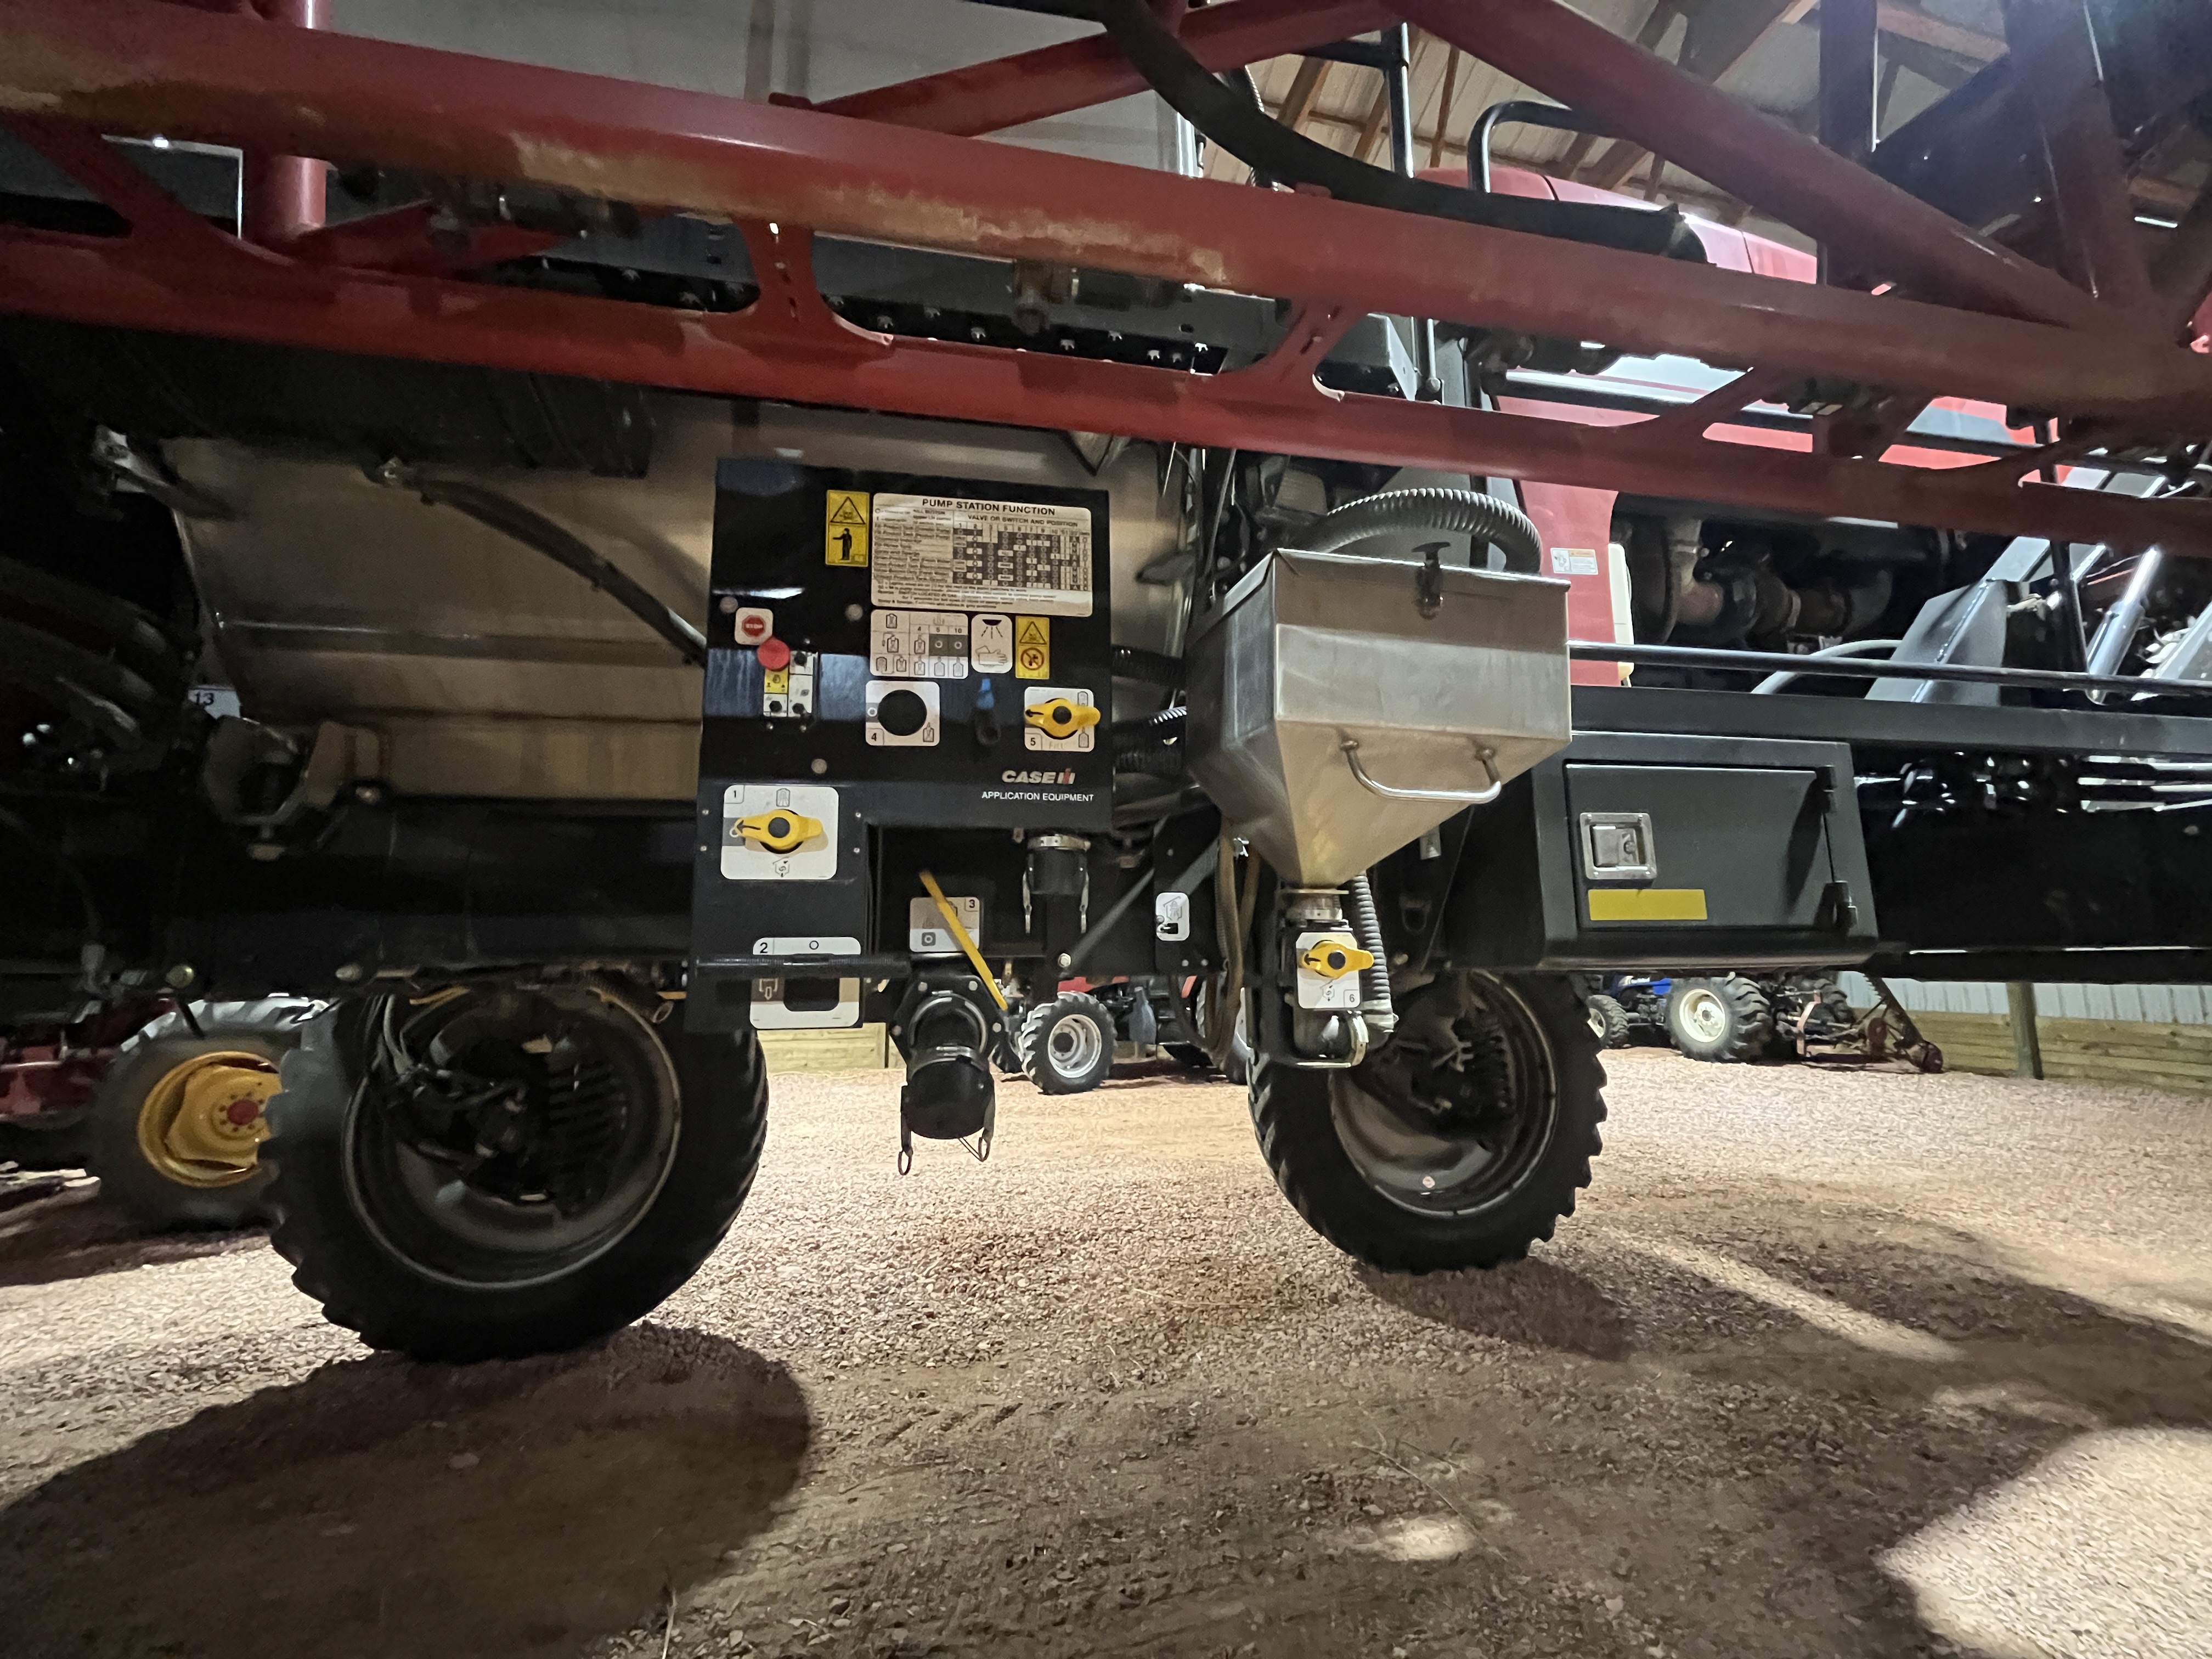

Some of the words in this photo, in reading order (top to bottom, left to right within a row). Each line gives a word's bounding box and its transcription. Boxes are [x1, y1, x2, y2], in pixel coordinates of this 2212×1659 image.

[922, 499, 953, 507] PUMP
[956, 501, 1000, 511] STATION
[1003, 505, 1056, 516] FUNCTION
[195, 692, 214, 706] 13
[871, 733, 877, 741] 4
[1030, 738, 1036, 746] 5
[1002, 770, 1056, 784] CASE
[981, 791, 1040, 800] APPLICATION
[1042, 793, 1094, 802] EQUIPMENT
[969, 899, 975, 908] 3
[760, 942, 768, 953] 2
[1349, 994, 1355, 1002] 6
